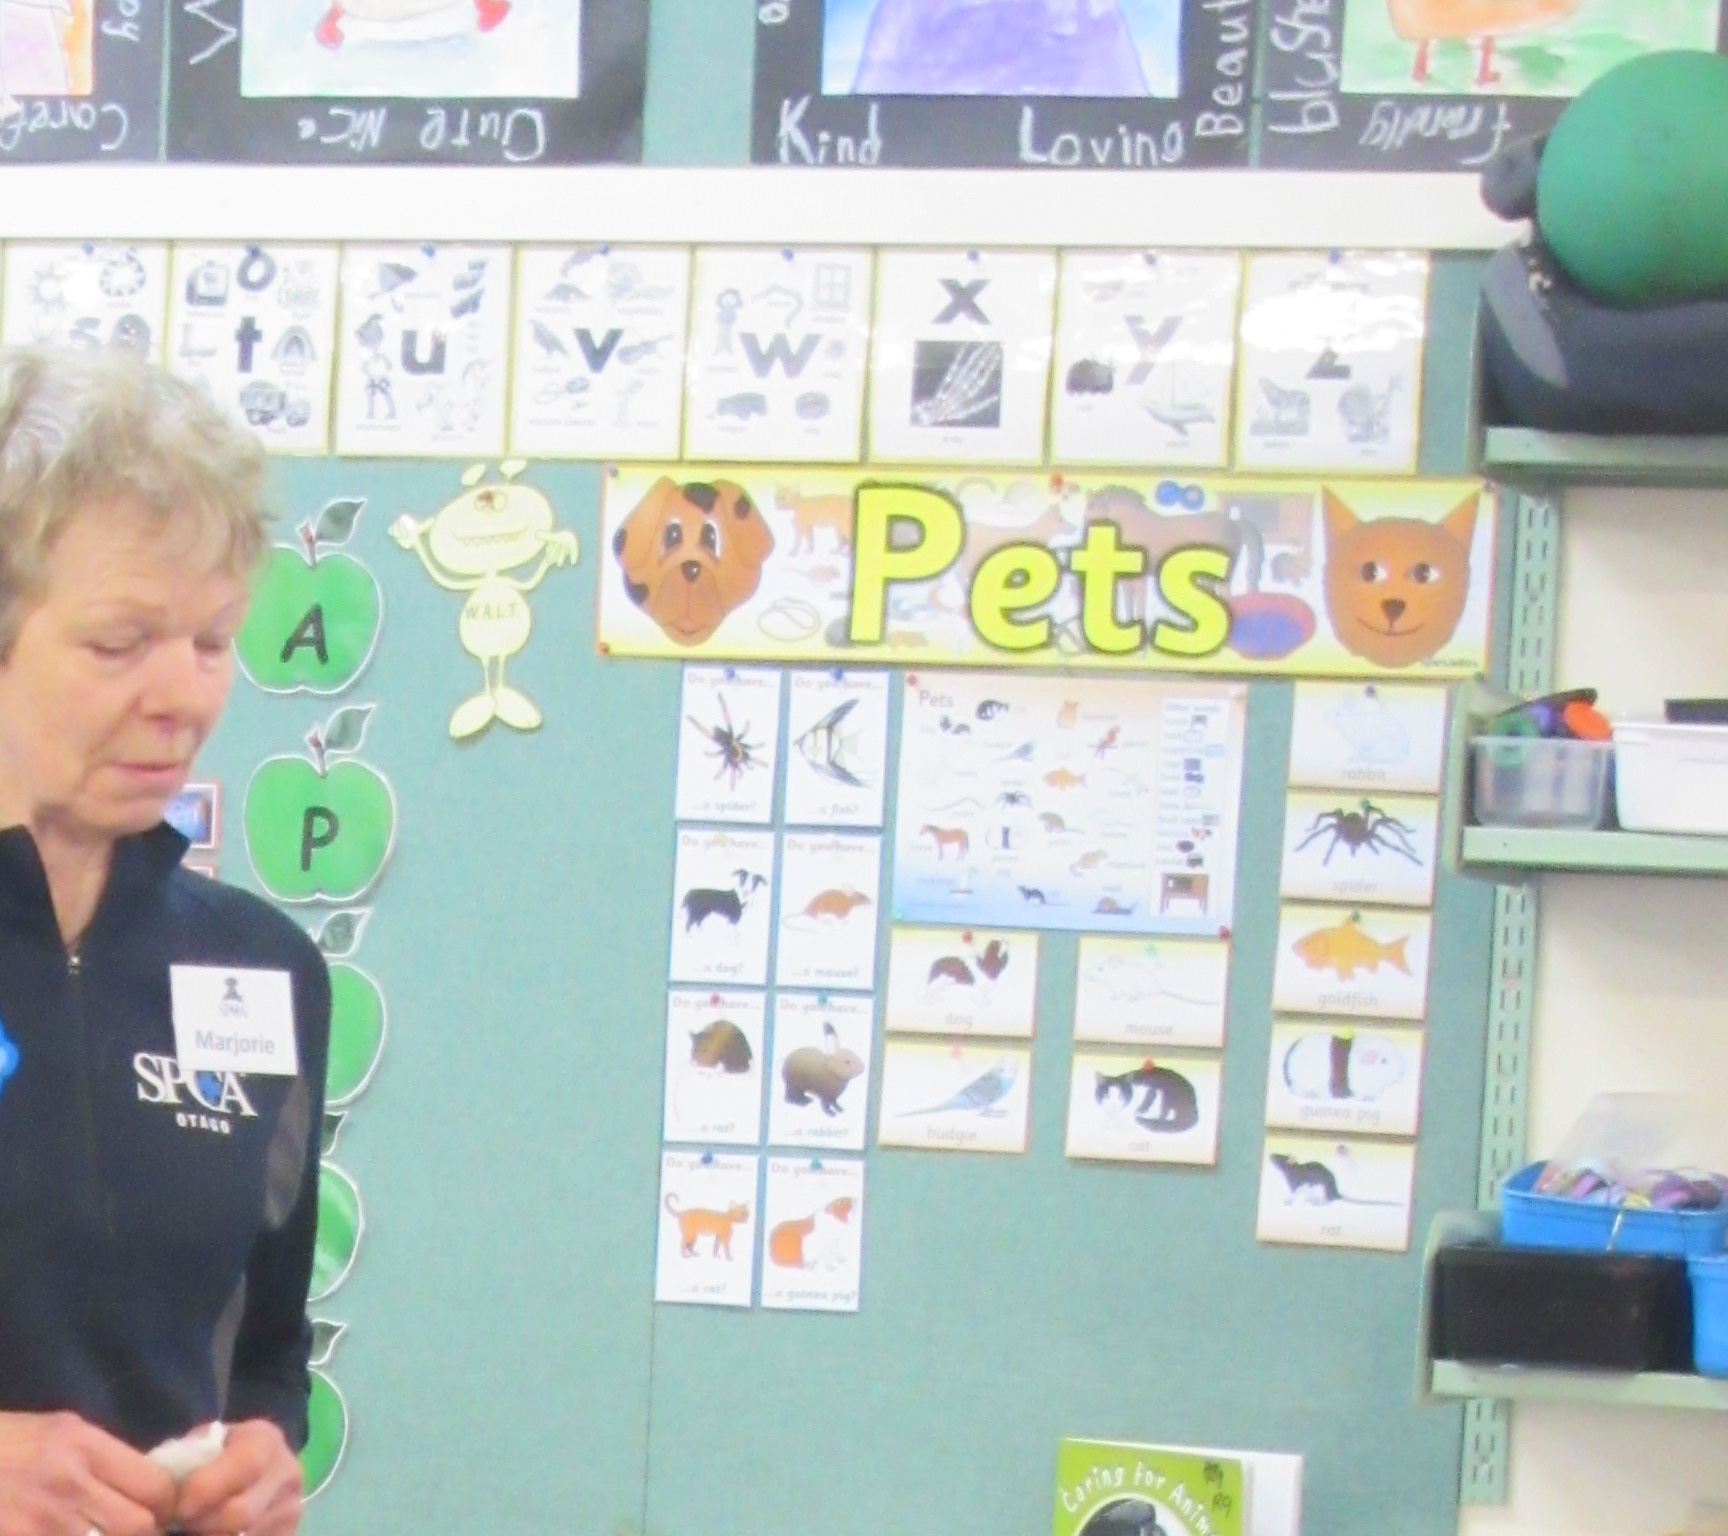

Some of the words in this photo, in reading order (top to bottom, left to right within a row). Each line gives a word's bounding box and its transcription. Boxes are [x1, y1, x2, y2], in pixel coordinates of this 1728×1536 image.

[777, 97, 882, 166] Kind
[1018, 105, 1186, 168] Loving
[932, 278, 991, 324] x
[234, 316, 264, 374] t
[399, 327, 448, 377] u
[572, 326, 626, 375] v
[1123, 315, 1183, 387] y
[738, 331, 824, 380] w
[846, 482, 1236, 656] Pets
[279, 603, 329, 665] A
[687, 672, 706, 685] Do
[794, 676, 813, 688] Do
[919, 689, 954, 709] Pets
[1340, 765, 1388, 782] rabbit
[301, 805, 340, 872] P
[681, 834, 700, 847] Do
[786, 838, 806, 851] Do
[1331, 878, 1379, 897] spider
[673, 996, 691, 1008] Do
[779, 998, 798, 1011] Do
[1317, 990, 1379, 1010] goldfish
[943, 1012, 975, 1030] dog
[1124, 1023, 1175, 1037] mouse
[195, 1028, 275, 1057] Marjorie
[133, 1051, 258, 1118] SPCA
[175, 1112, 232, 1135] OTAGO
[1299, 1104, 1352, 1124] guinea
[1355, 1105, 1381, 1126] pig
[926, 1124, 977, 1144] budgie
[1127, 1140, 1153, 1152] cat
[665, 1156, 684, 1169] Do
[771, 1162, 790, 1175] Do
[1320, 1223, 1343, 1236] rat
[1060, 1463, 1125, 1514] Caring
[1133, 1460, 1167, 1492] for
